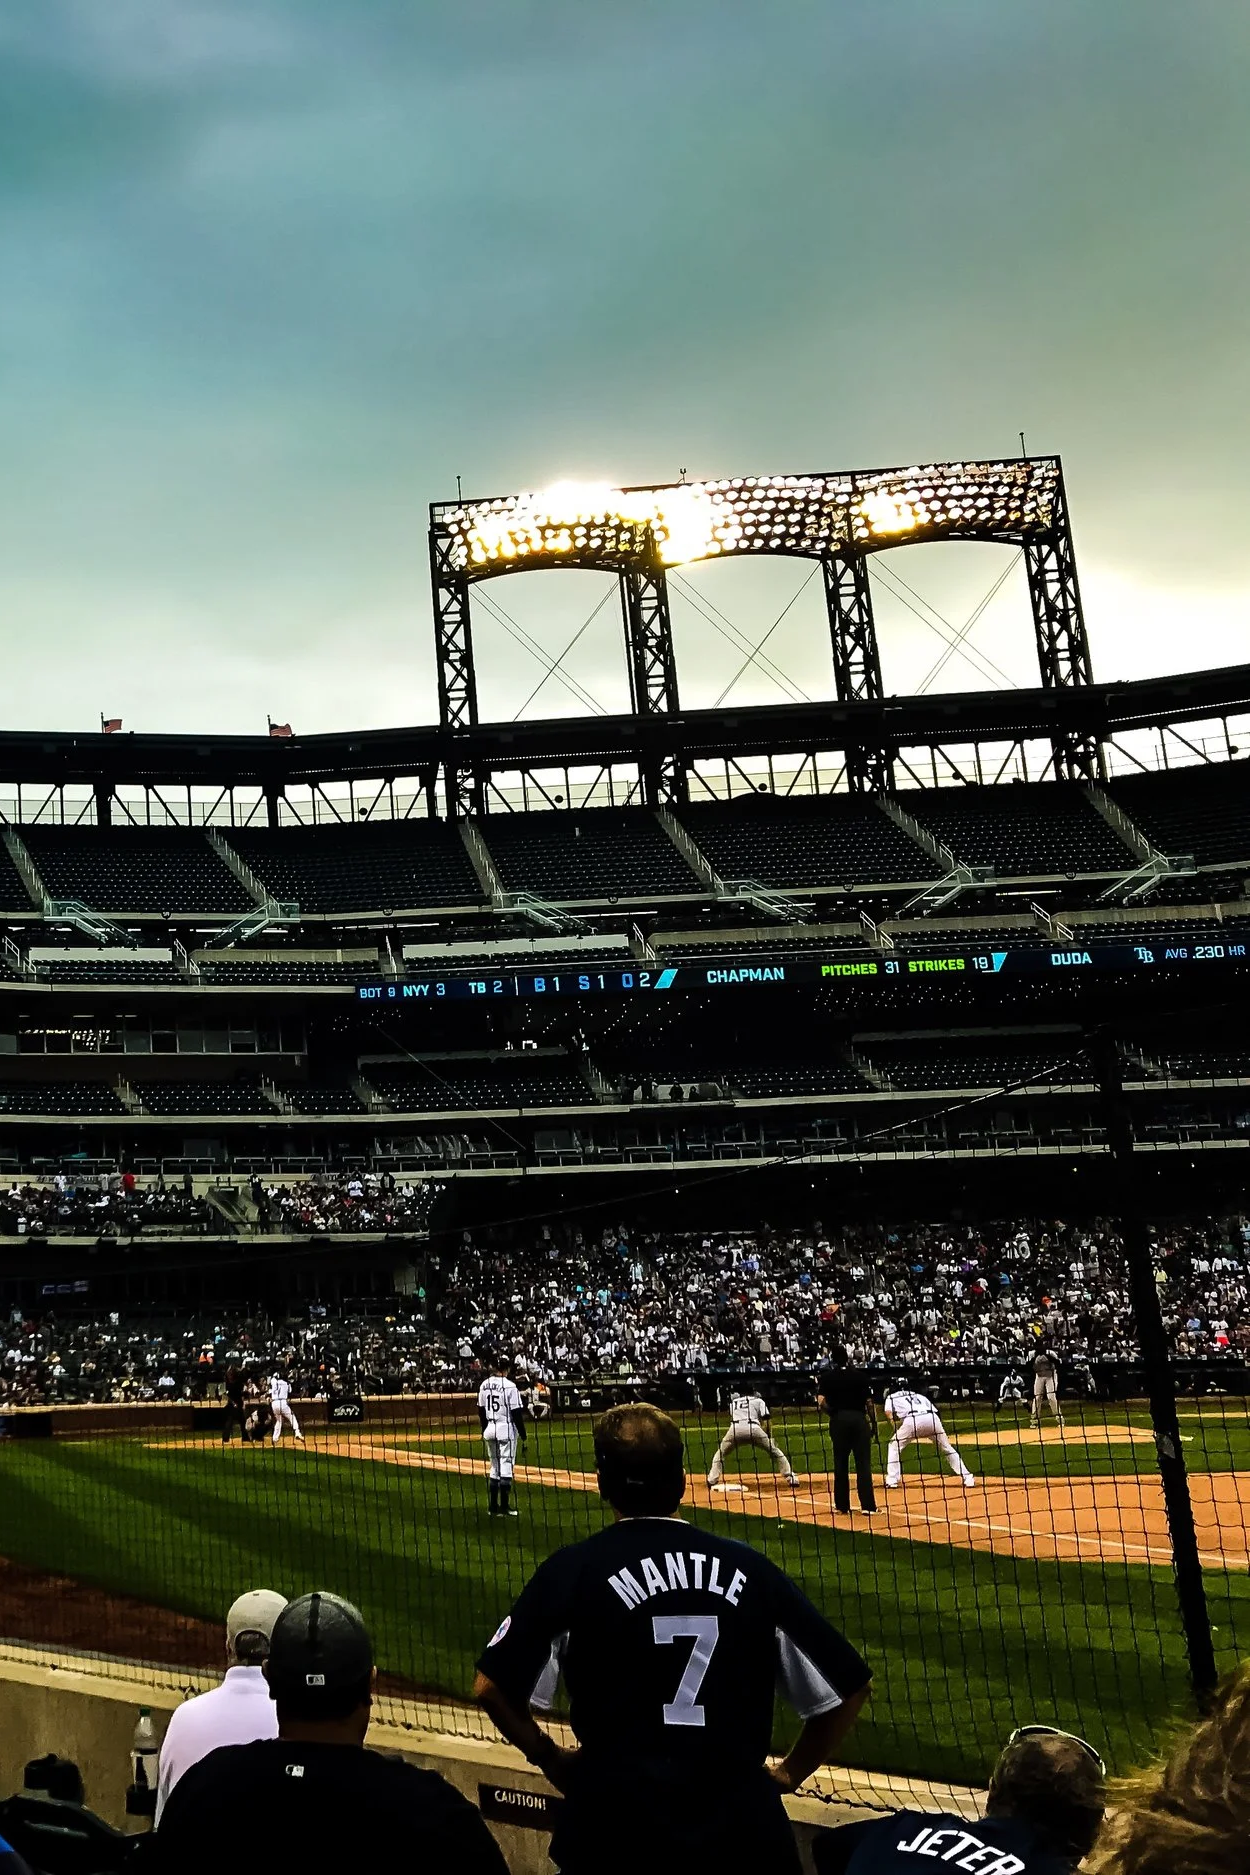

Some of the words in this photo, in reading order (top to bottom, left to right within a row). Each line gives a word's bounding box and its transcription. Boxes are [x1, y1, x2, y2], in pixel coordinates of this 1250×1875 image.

[1052, 952, 1092, 965] DUDA
[1165, 949, 1187, 959] AVG
[1192, 946, 1224, 959] .230
[1229, 945, 1246, 956] HR
[707, 967, 785, 983] CHAPMAN
[822, 963, 877, 976] PITCHES
[885, 961, 899, 974] 31
[908, 959, 965, 972] STRIKES
[972, 957, 988, 970] 19
[360, 988, 381, 998] BOT
[388, 987, 395, 997] 9
[403, 985, 429, 997] NYY
[436, 984, 445, 996] 3
[469, 982, 486, 994] TB
[493, 981, 502, 993] 2
[534, 978, 546, 992] B
[553, 977, 560, 991] 1
[579, 976, 590, 990] S
[598, 975, 605, 989] 1
[639, 973, 650, 987] 2
[487, 1395, 500, 1412] 15
[607, 1552, 747, 1610] MANTLE
[652, 1615, 719, 1726] 7
[494, 1790, 547, 1811] CAUTION!
[897, 1828, 1025, 1875] JETER
